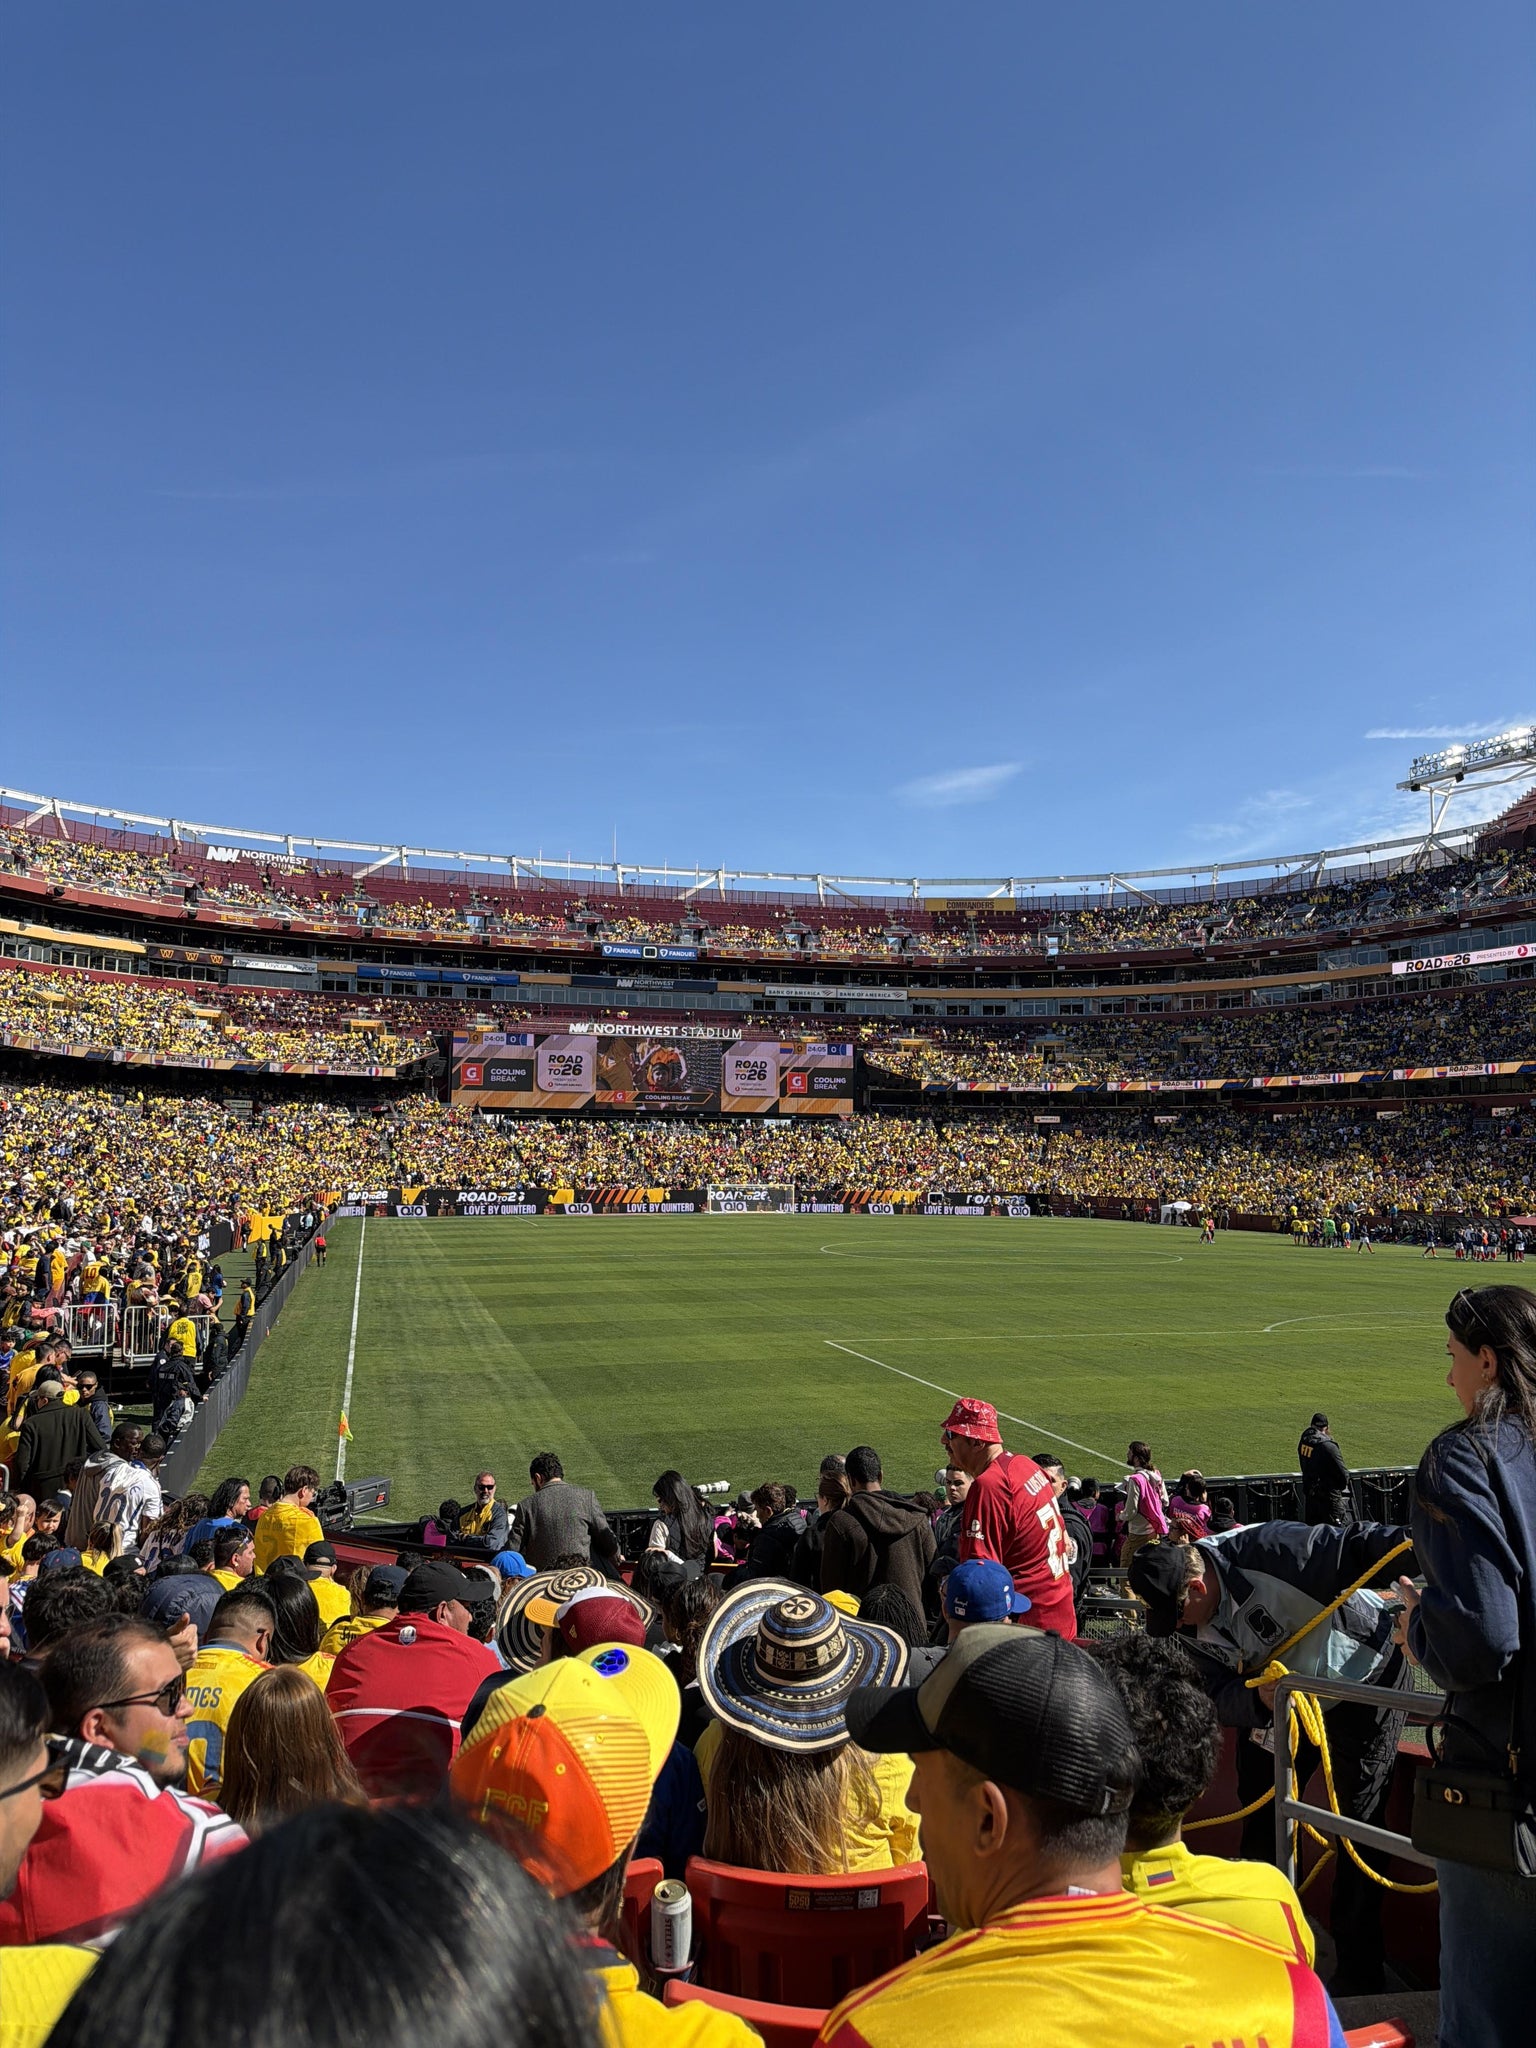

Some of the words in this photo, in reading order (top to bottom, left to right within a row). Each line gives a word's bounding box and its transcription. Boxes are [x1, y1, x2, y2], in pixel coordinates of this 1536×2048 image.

[206, 846, 240, 862] NW
[242, 850, 308, 866] NORTHWEST
[946, 901, 995, 909] COMMANDERS
[612, 947, 641, 955] FANDUEL
[668, 950, 696, 958] FANDUEL
[1406, 957, 1443, 972] ROAD
[1454, 953, 1471, 966] 26
[1476, 951, 1507, 960] PRESENTED
[389, 969, 417, 978] FANDUEL
[569, 1023, 590, 1034] NW
[593, 1024, 678, 1036] NORTHWEST
[681, 1027, 742, 1038] STADIUM
[510, 1035, 516, 1043] 0
[548, 1055, 583, 1064] ROAD
[735, 1060, 768, 1069] ROAD
[490, 1068, 527, 1076] COOLING
[548, 1068, 561, 1076] TO
[560, 1064, 583, 1076] 26
[747, 1069, 768, 1081] 26
[347, 1191, 368, 1200] ROAD
[376, 1190, 388, 1199] 26
[457, 1192, 497, 1202] ROAD
[337, 1206, 366, 1217] UINTERO
[464, 1204, 486, 1215] LOVE
[488, 1204, 500, 1215] BY
[501, 1204, 537, 1215] QUINTERO
[627, 1203, 647, 1213] LOVE
[650, 1203, 659, 1213] BY
[661, 1202, 694, 1213] QUINTERO
[780, 1203, 799, 1213] LOVE
[801, 1203, 811, 1213] BY
[812, 1203, 844, 1213] QUINTERO
[924, 1205, 942, 1215] LOVE
[944, 1205, 953, 1215] BY
[954, 1205, 985, 1215] QUINTERO
[85, 1267, 97, 1280] 10
[186, 1686, 223, 1709] MES
[664, 1918, 673, 1950] STELLA
